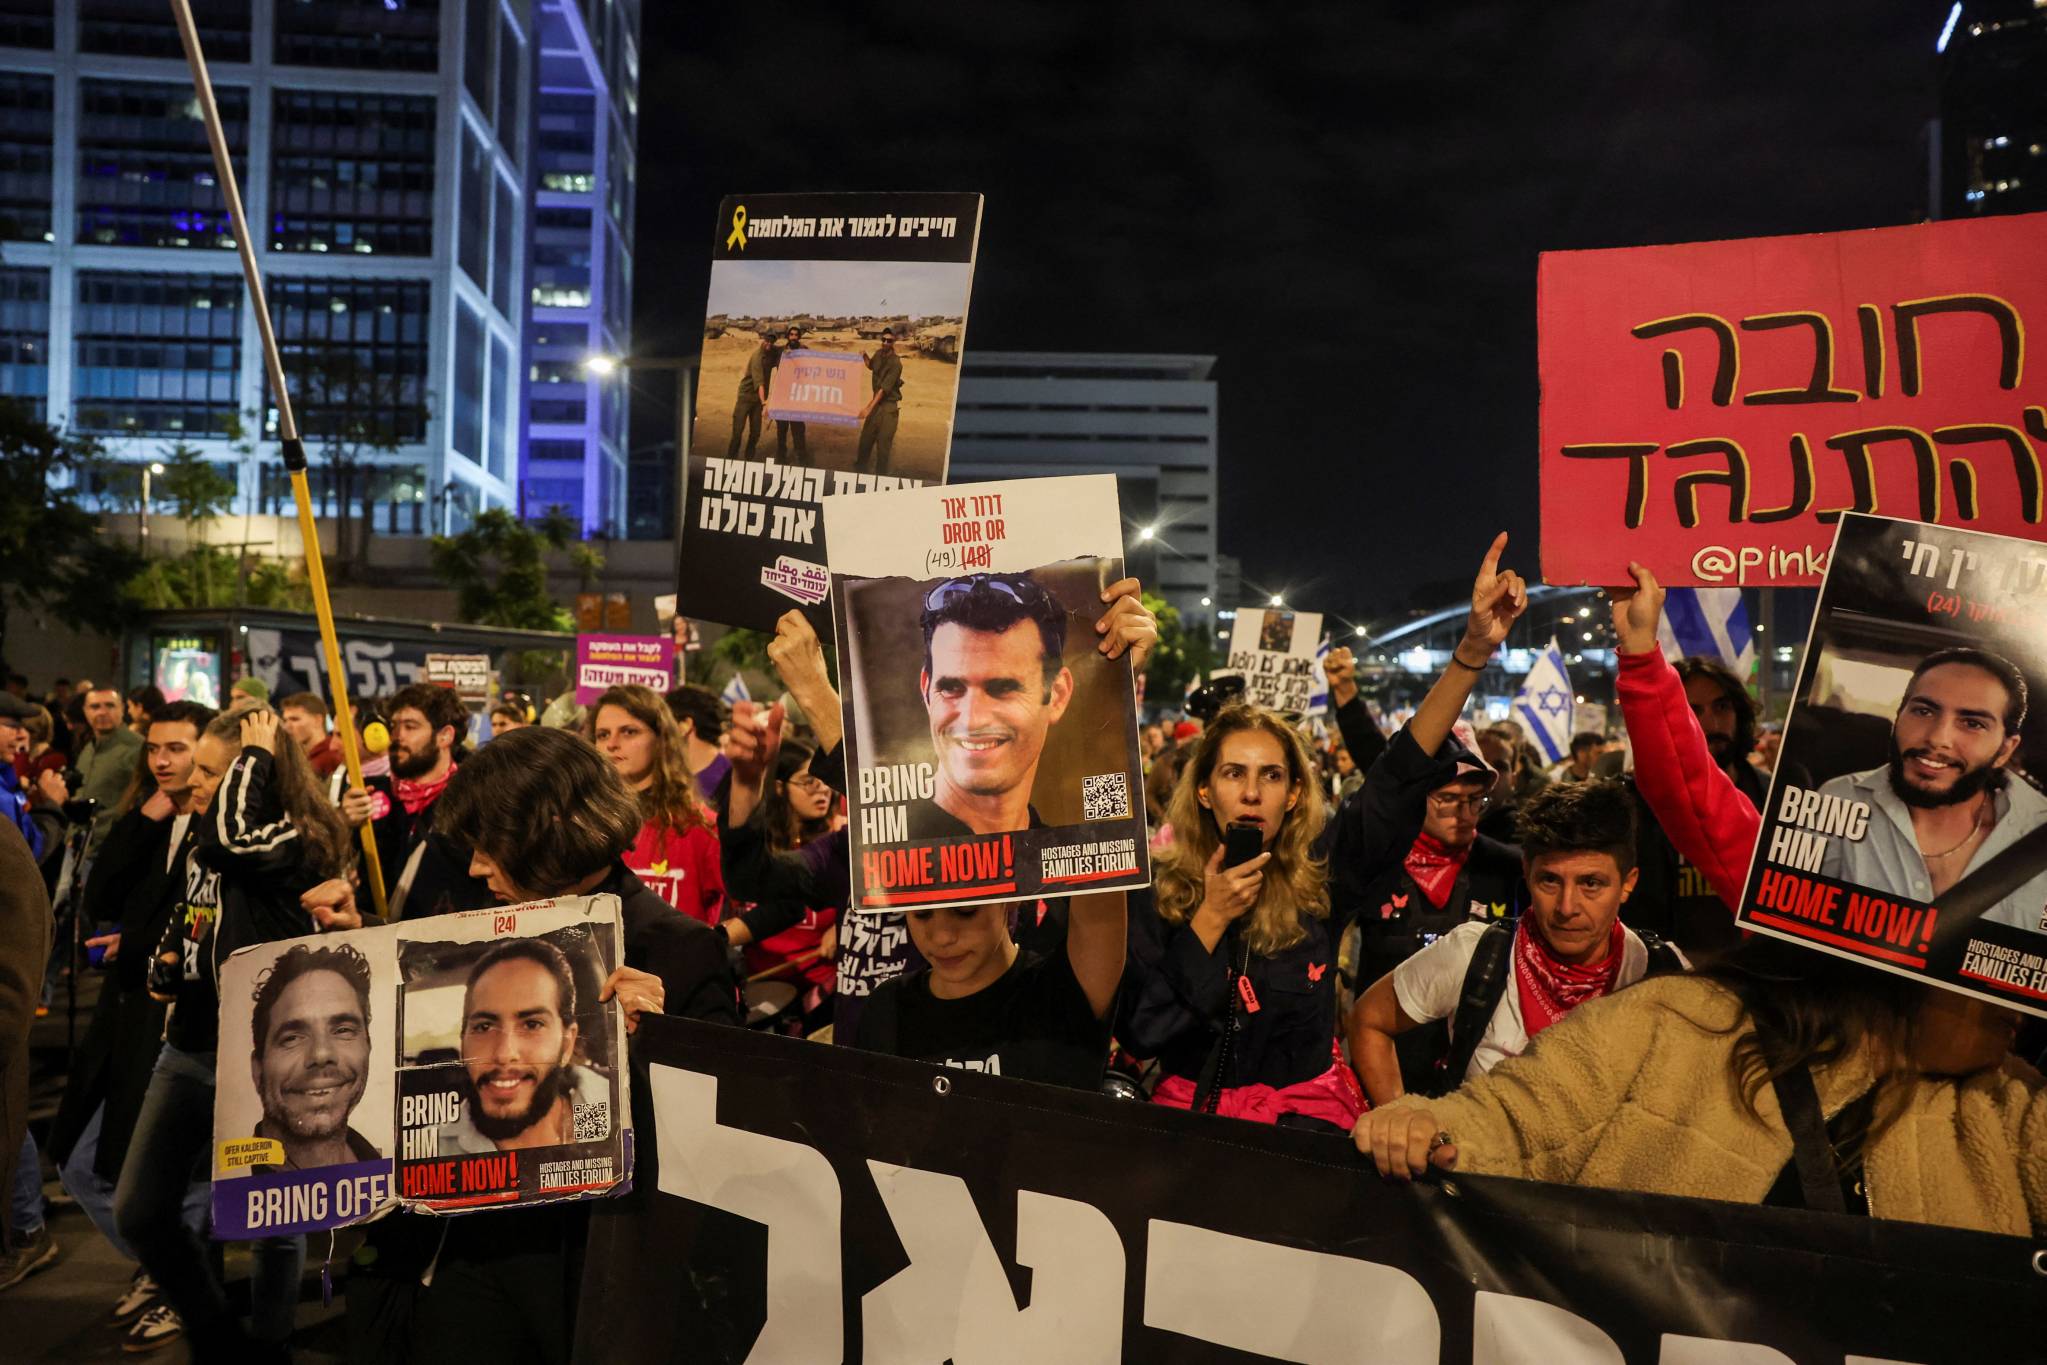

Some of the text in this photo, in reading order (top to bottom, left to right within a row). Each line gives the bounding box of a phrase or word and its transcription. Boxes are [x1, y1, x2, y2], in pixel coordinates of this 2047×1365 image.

[747, 213, 957, 238] חייבים לגמור את המלחמה
[1632, 293, 2024, 411] חובה
[703, 457, 826, 504] המלחמה
[699, 493, 816, 545] את כולנו
[941, 494, 1002, 520] דרור אור
[942, 519, 1006, 545] DROR OR
[925, 547, 956, 575] (49)
[764, 570, 827, 592] עומדים ביחד
[1927, 591, 1962, 619] (24)
[585, 668, 664, 688] לצאת מעזה!
[859, 762, 936, 804] BRING
[860, 805, 908, 845] HIM
[1777, 785, 1871, 841] BRING
[862, 834, 1015, 890] HOME NOW!
[1041, 839, 1135, 861] HOSTAGES AND MISSING
[1041, 851, 1137, 879] FAMILIES FORUM
[1767, 826, 1829, 874] HIM
[494, 914, 517, 936] (24)
[1756, 869, 1842, 927] HOME
[1842, 895, 1938, 953] NOW!
[1962, 952, 2030, 988] FAMILIES
[1967, 938, 2021, 964] HOSTAGES
[2019, 953, 2043, 970] AND
[402, 1091, 460, 1127] BRING
[224, 1140, 272, 1156] OFER KALDERON
[227, 1152, 270, 1167] STILL CAPTIVE
[402, 1127, 439, 1160] HIM
[402, 1151, 519, 1198] HOME NOW!
[539, 1156, 613, 1174] HOSTAGES AND MISSING
[539, 1167, 613, 1190] FAMILIES FORUM
[247, 1182, 328, 1229] BRING
